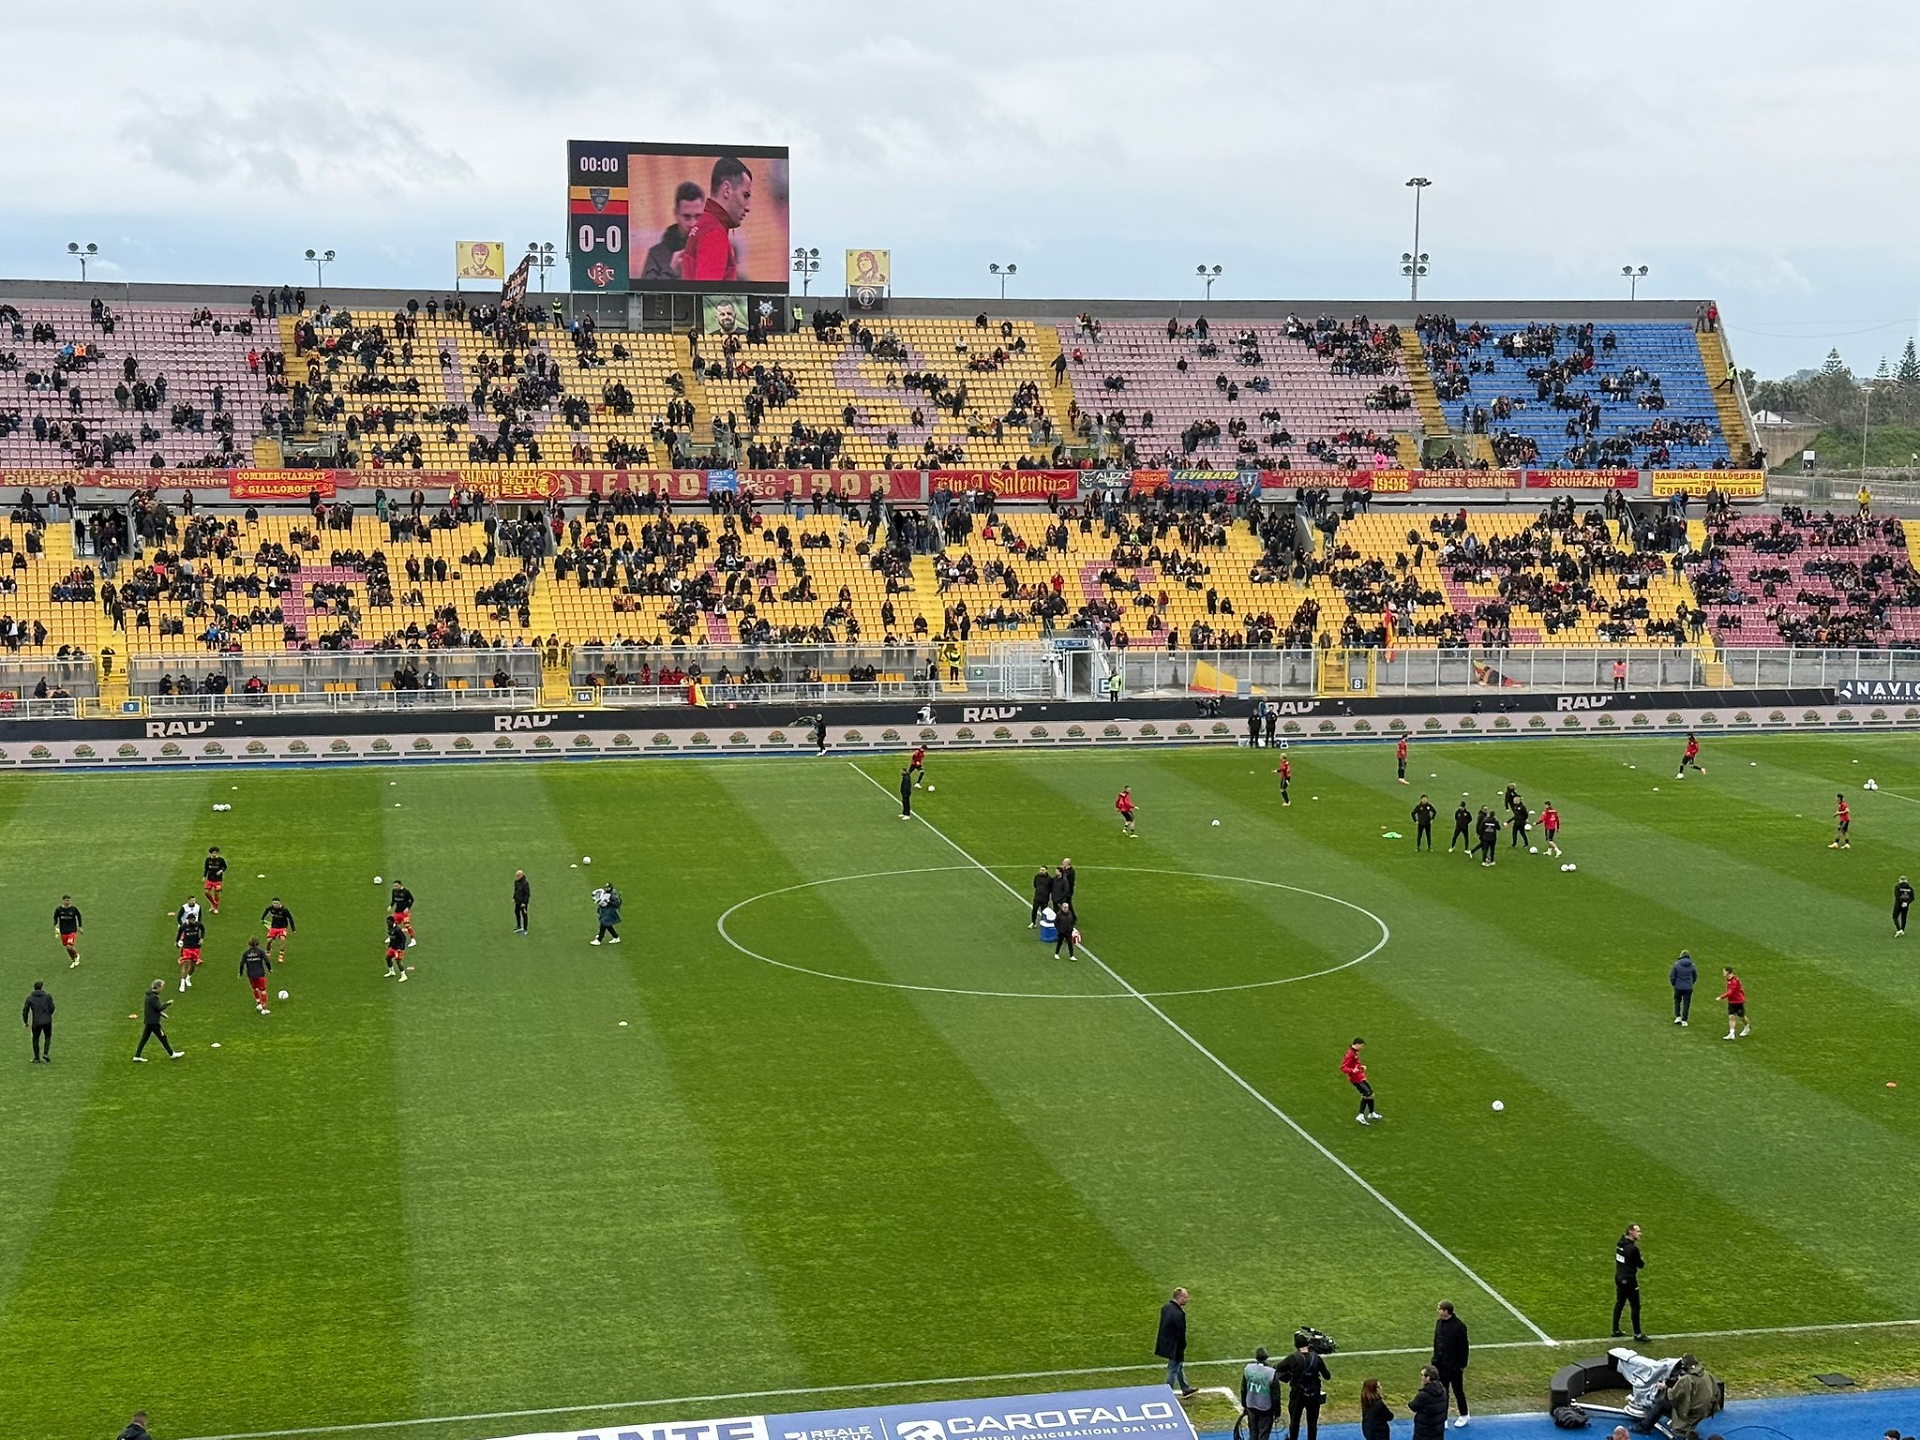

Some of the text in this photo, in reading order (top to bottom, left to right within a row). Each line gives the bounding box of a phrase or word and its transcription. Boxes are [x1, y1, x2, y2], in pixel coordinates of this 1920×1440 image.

[580, 156, 619, 172] 00:00
[579, 224, 622, 253] 0-0
[4, 475, 85, 486] RUFFANO
[236, 471, 326, 480] COMMERCIALISTI
[501, 470, 539, 479] QUELLI
[1173, 471, 1239, 480] LEVERANO
[100, 475, 228, 488] Campi Salentina
[359, 476, 422, 488] ALLISTE
[560, 473, 700, 496] ALENTO
[1283, 476, 1349, 488] CAPRARICA
[1373, 477, 1409, 492] 1908
[1417, 477, 1452, 487] TORRE
[1466, 477, 1516, 487] SUSANNA
[1549, 476, 1616, 488] SQUINZANO
[501, 485, 535, 495] EST
[946, 1402, 1174, 1434] CAROFALO
[810, 1425, 872, 1439] REALE
[1021, 1427, 1118, 1440] ASSICURAZIONE
[1122, 1425, 1146, 1434] DAL
[1150, 1422, 1178, 1431] 1989
